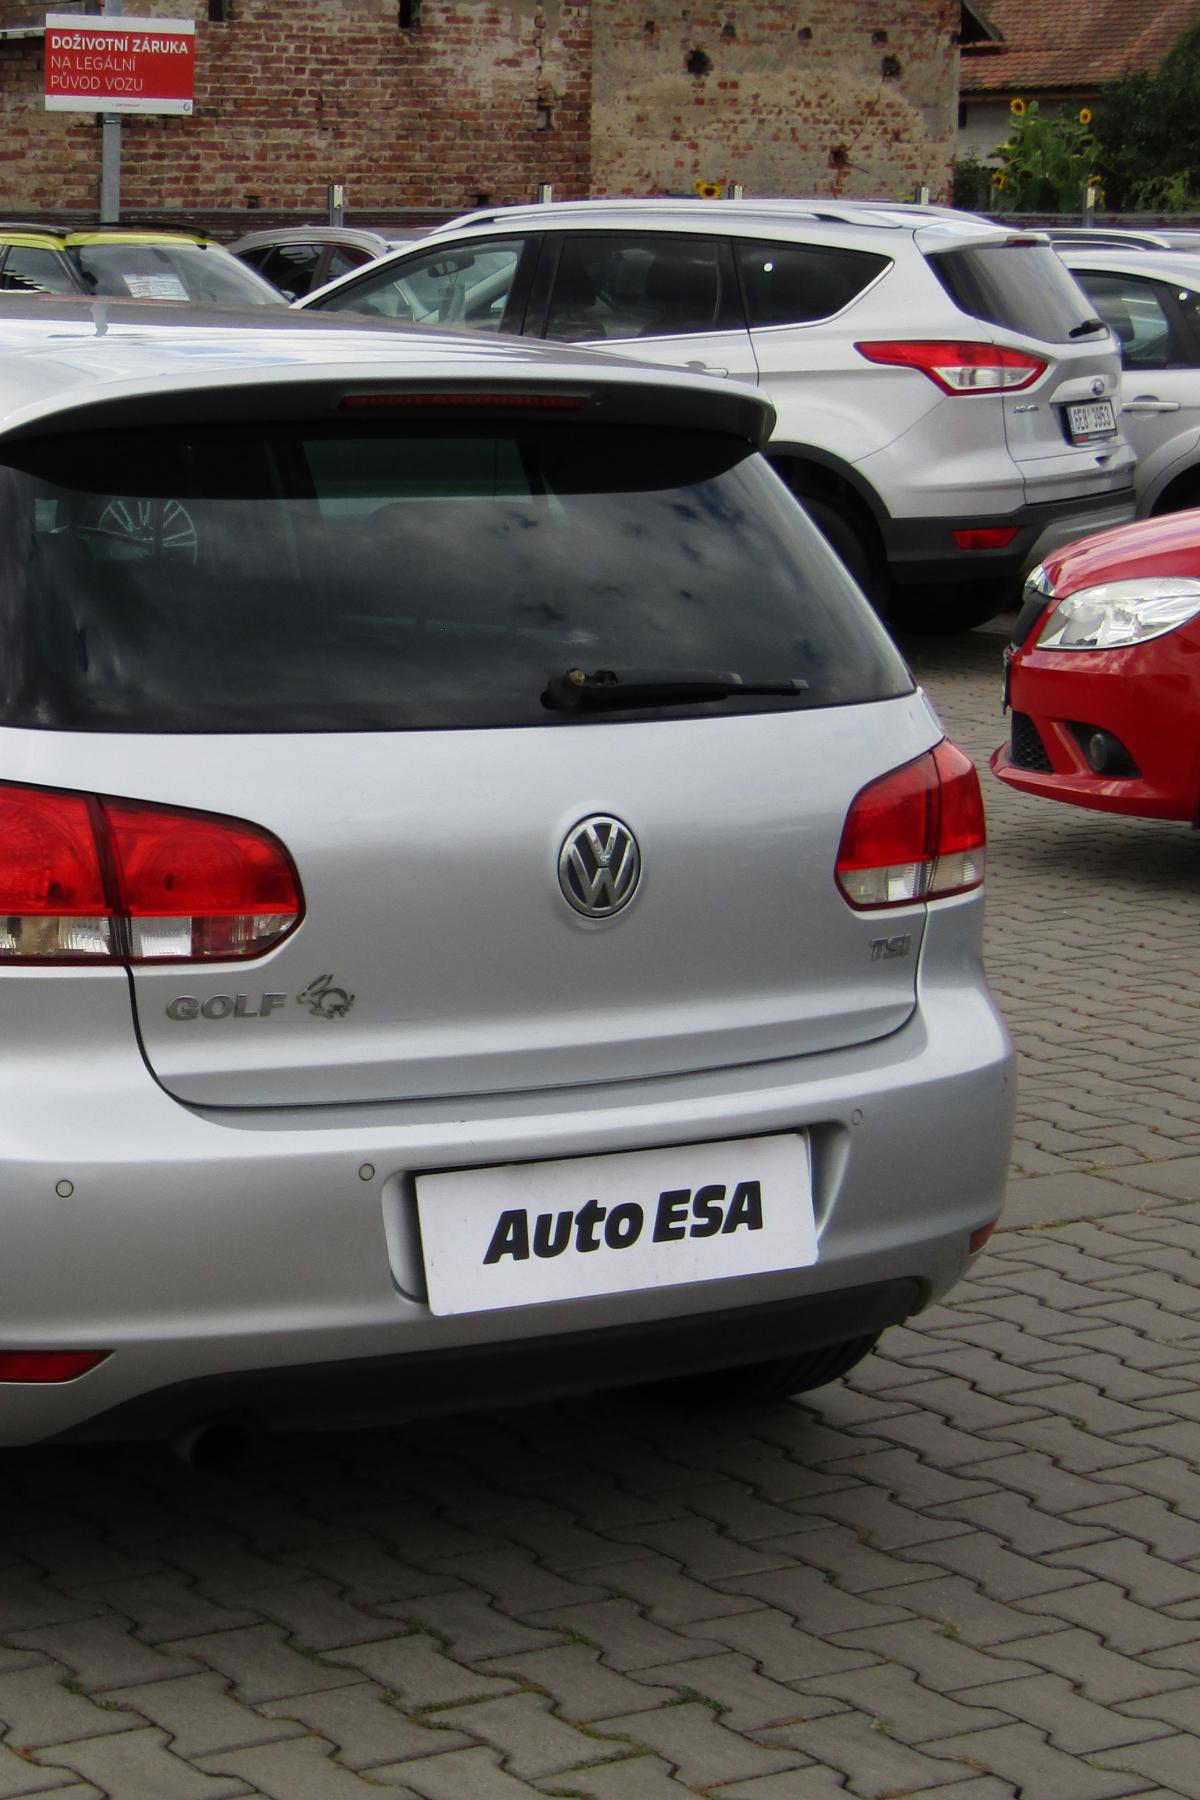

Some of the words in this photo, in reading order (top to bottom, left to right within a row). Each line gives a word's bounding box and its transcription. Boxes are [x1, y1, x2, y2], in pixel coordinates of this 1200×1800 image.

[52, 34, 129, 51] DOŽIVOTNÍ
[132, 36, 188, 54] ZÁRUKA
[51, 56, 71, 69] NA
[76, 55, 136, 71] LEGÁLNÍ
[51, 72, 100, 89] PŮVOD
[105, 77, 143, 91] VOZU
[166, 992, 288, 1021] GOLF
[483, 1200, 644, 1264] Auto
[653, 1180, 763, 1243] ESA
